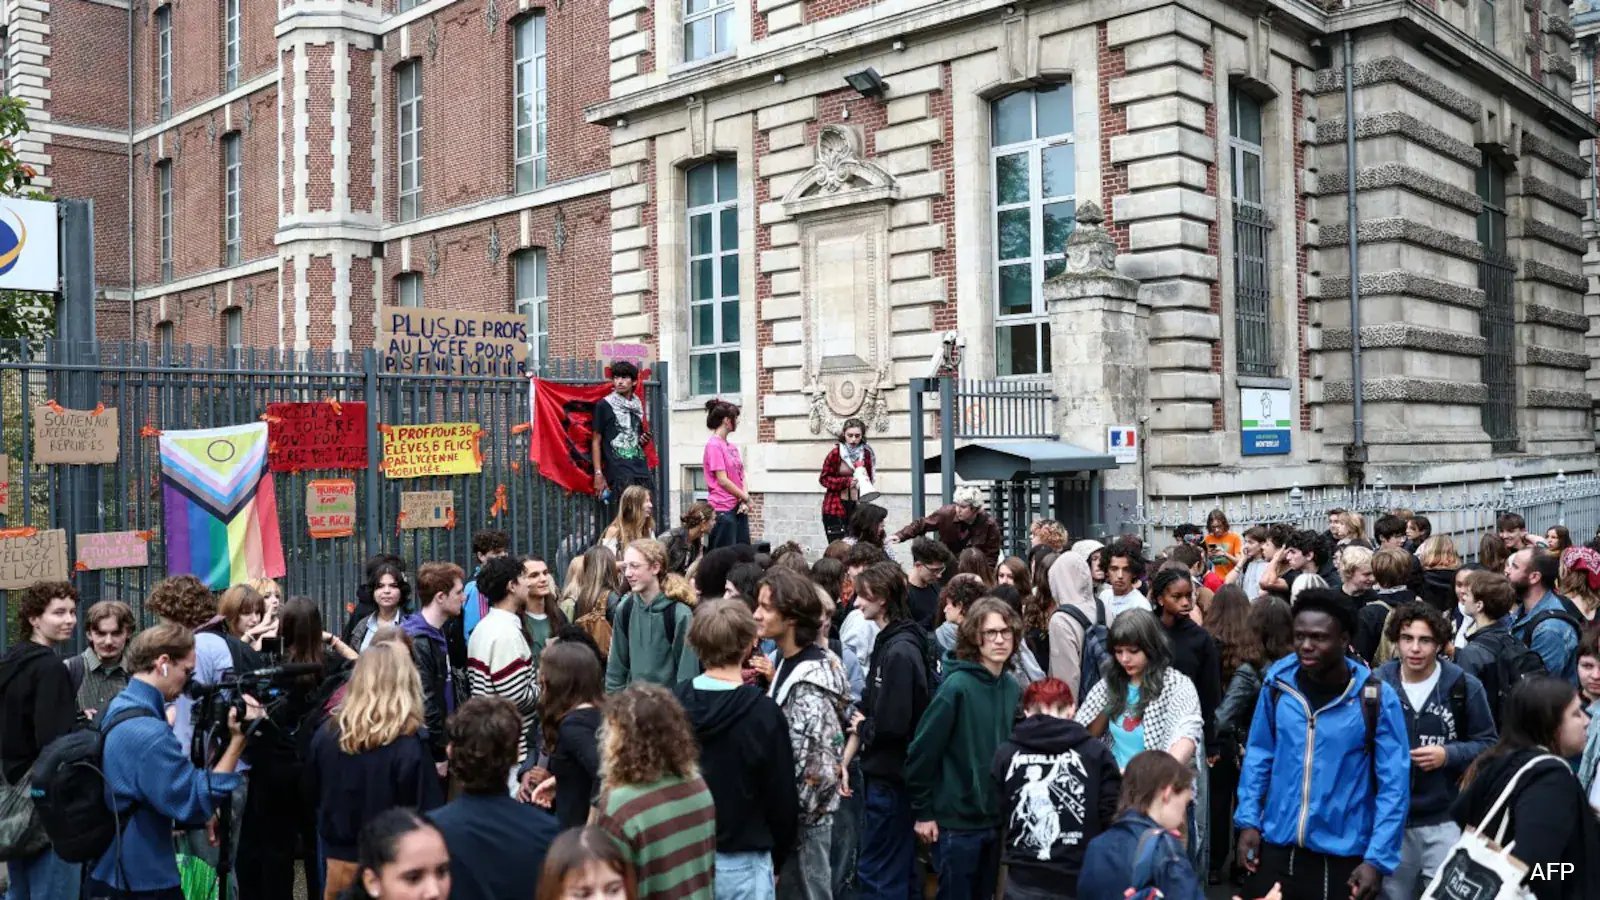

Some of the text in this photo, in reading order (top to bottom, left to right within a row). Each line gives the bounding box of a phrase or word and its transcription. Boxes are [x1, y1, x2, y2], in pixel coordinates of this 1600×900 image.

[392, 313, 528, 343] PLUS DE PROFS
[389, 338, 411, 355] AU
[475, 341, 514, 360] POUR
[385, 355, 413, 371] PS
[44, 411, 93, 427] SOUTIEN
[398, 426, 431, 440] PROF
[458, 425, 473, 436] 36
[432, 440, 440, 452] 6
[444, 439, 472, 451] FLICS
[386, 456, 408, 467] PAR
[309, 515, 326, 527] THE
[1004, 748, 1089, 782] METALLICA
